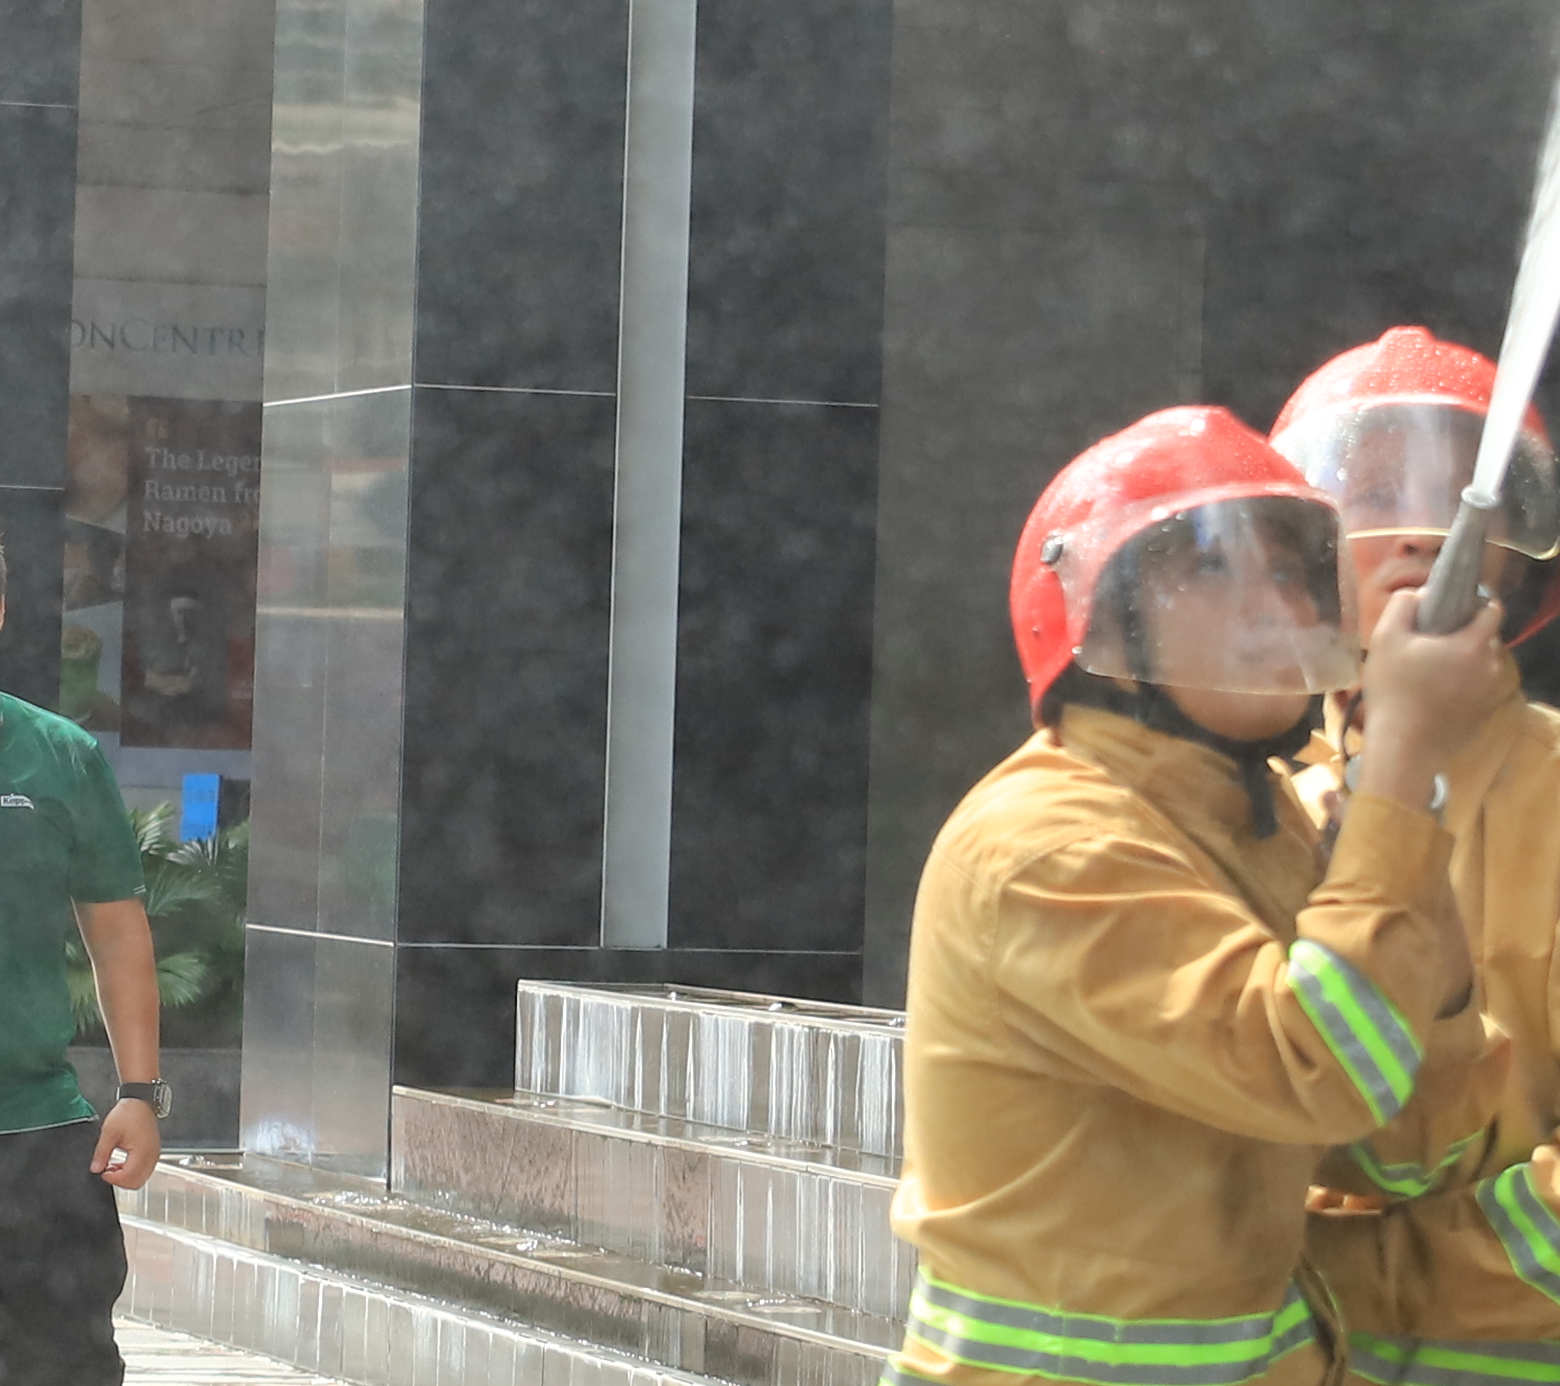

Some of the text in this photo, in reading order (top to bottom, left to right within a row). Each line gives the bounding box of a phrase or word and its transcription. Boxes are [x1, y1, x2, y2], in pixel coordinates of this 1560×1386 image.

[144, 445, 191, 471] The
[143, 479, 228, 503] Ramen
[142, 509, 233, 539] Nagoya
